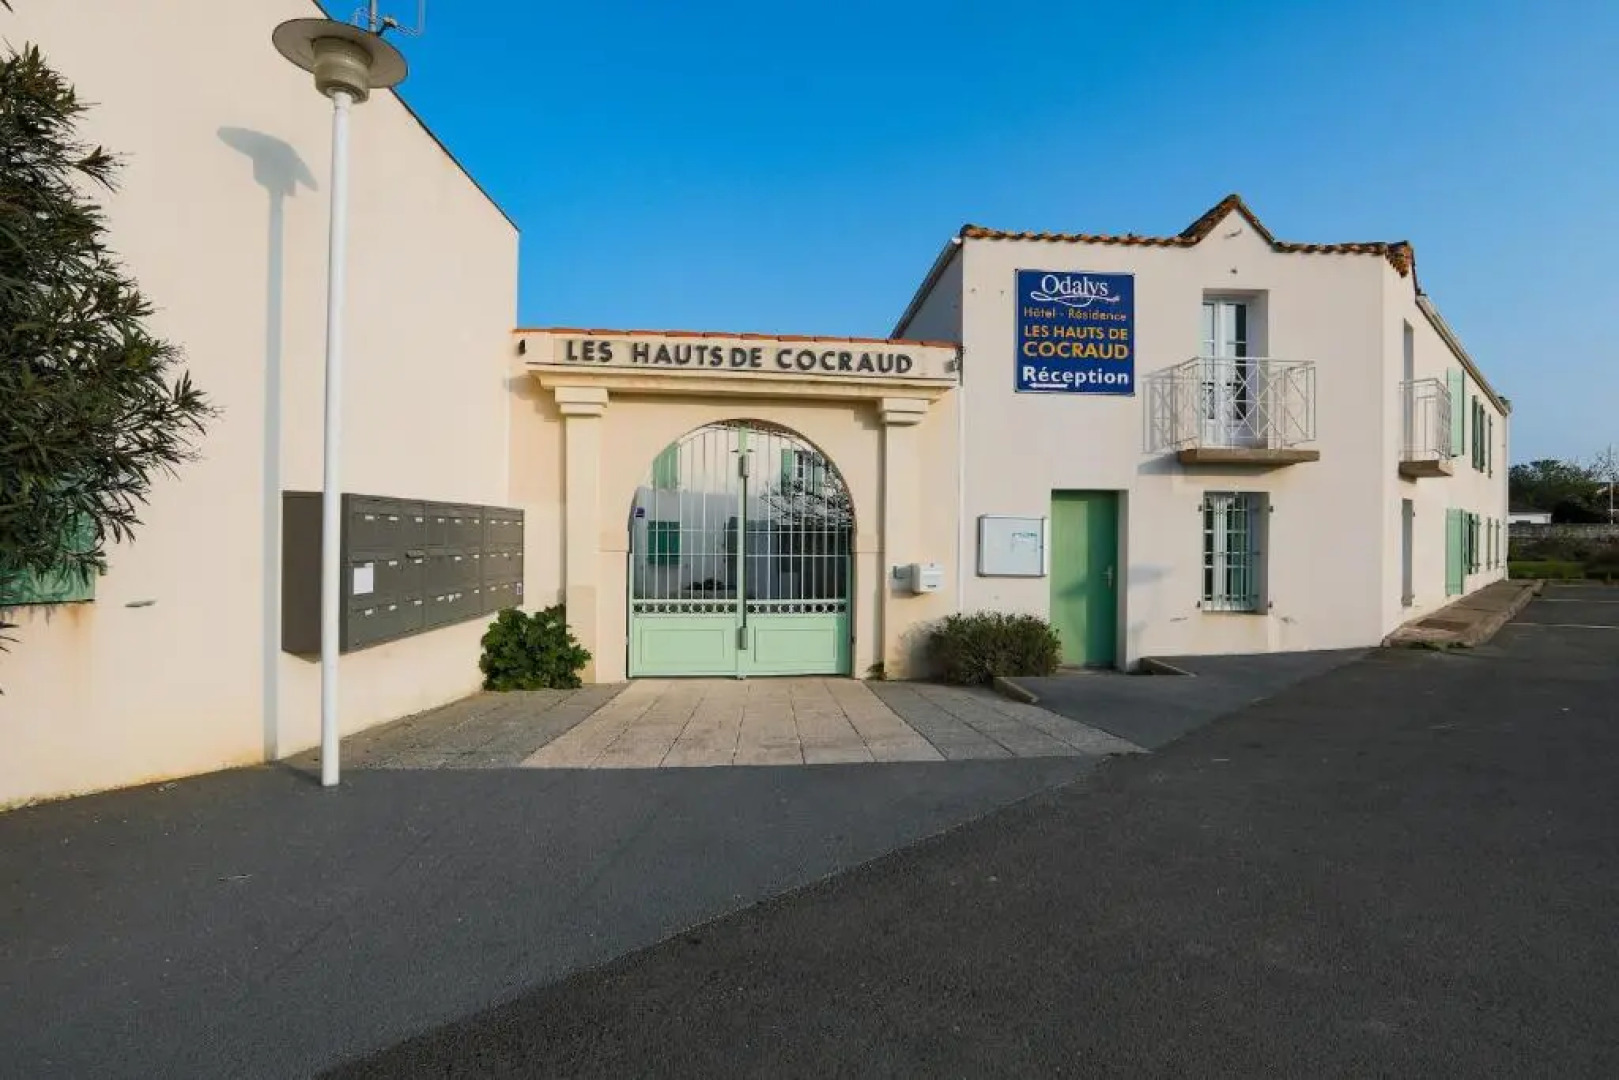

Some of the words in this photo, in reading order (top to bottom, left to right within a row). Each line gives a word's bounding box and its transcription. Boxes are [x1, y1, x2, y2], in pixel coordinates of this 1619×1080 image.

[1041, 274, 1108, 297] Odalys
[1024, 325, 1049, 338] LES
[1053, 326, 1104, 339] HAUTS
[1109, 328, 1128, 340] DE
[565, 340, 613, 362] LES
[633, 342, 725, 368] HAUTS
[730, 346, 762, 368] DE
[776, 349, 913, 374] COCRAUD
[1023, 341, 1128, 359] COCRAUD
[1022, 366, 1128, 387] Réception
